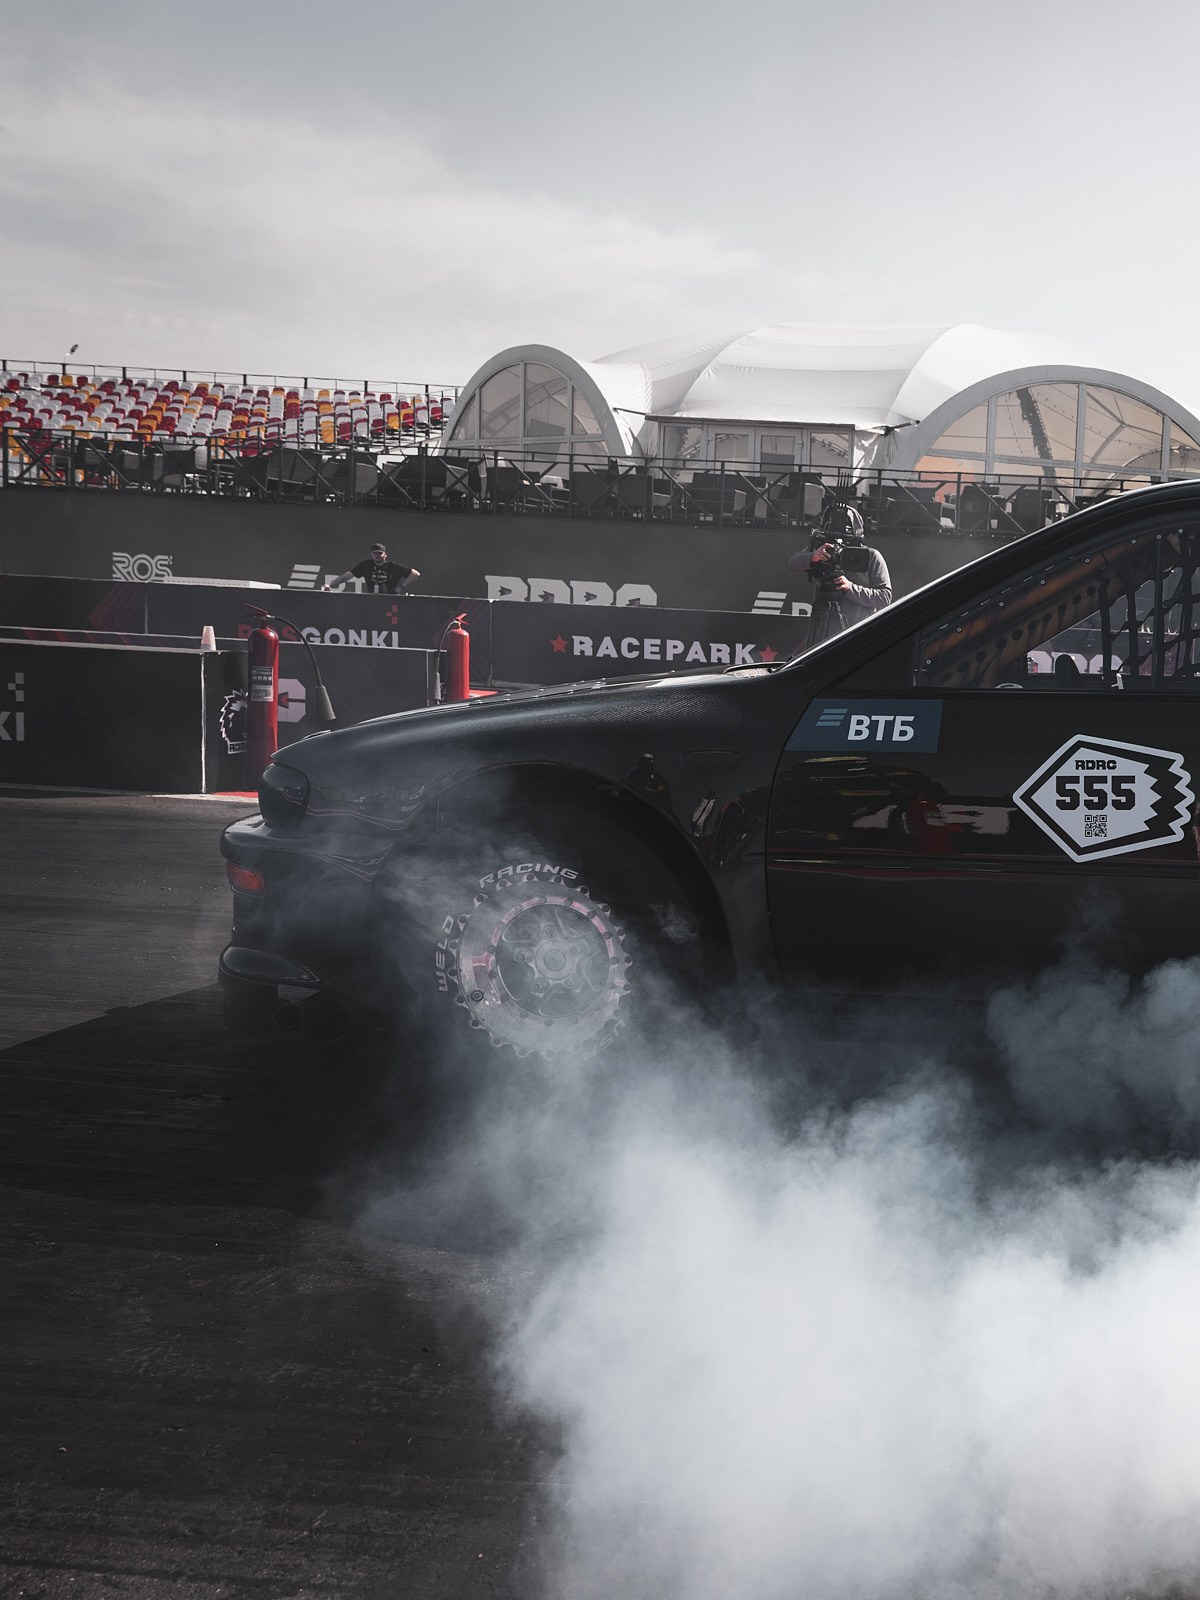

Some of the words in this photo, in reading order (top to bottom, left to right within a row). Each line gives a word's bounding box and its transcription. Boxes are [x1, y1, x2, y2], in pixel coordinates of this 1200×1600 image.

[112, 551, 173, 582] ROS
[572, 635, 757, 664] RACEPARK
[846, 713, 915, 742] ВТБ
[1075, 759, 1117, 771] RDRC
[1055, 775, 1136, 811] 555
[478, 862, 579, 888] RACING
[435, 914, 454, 992] WELD
